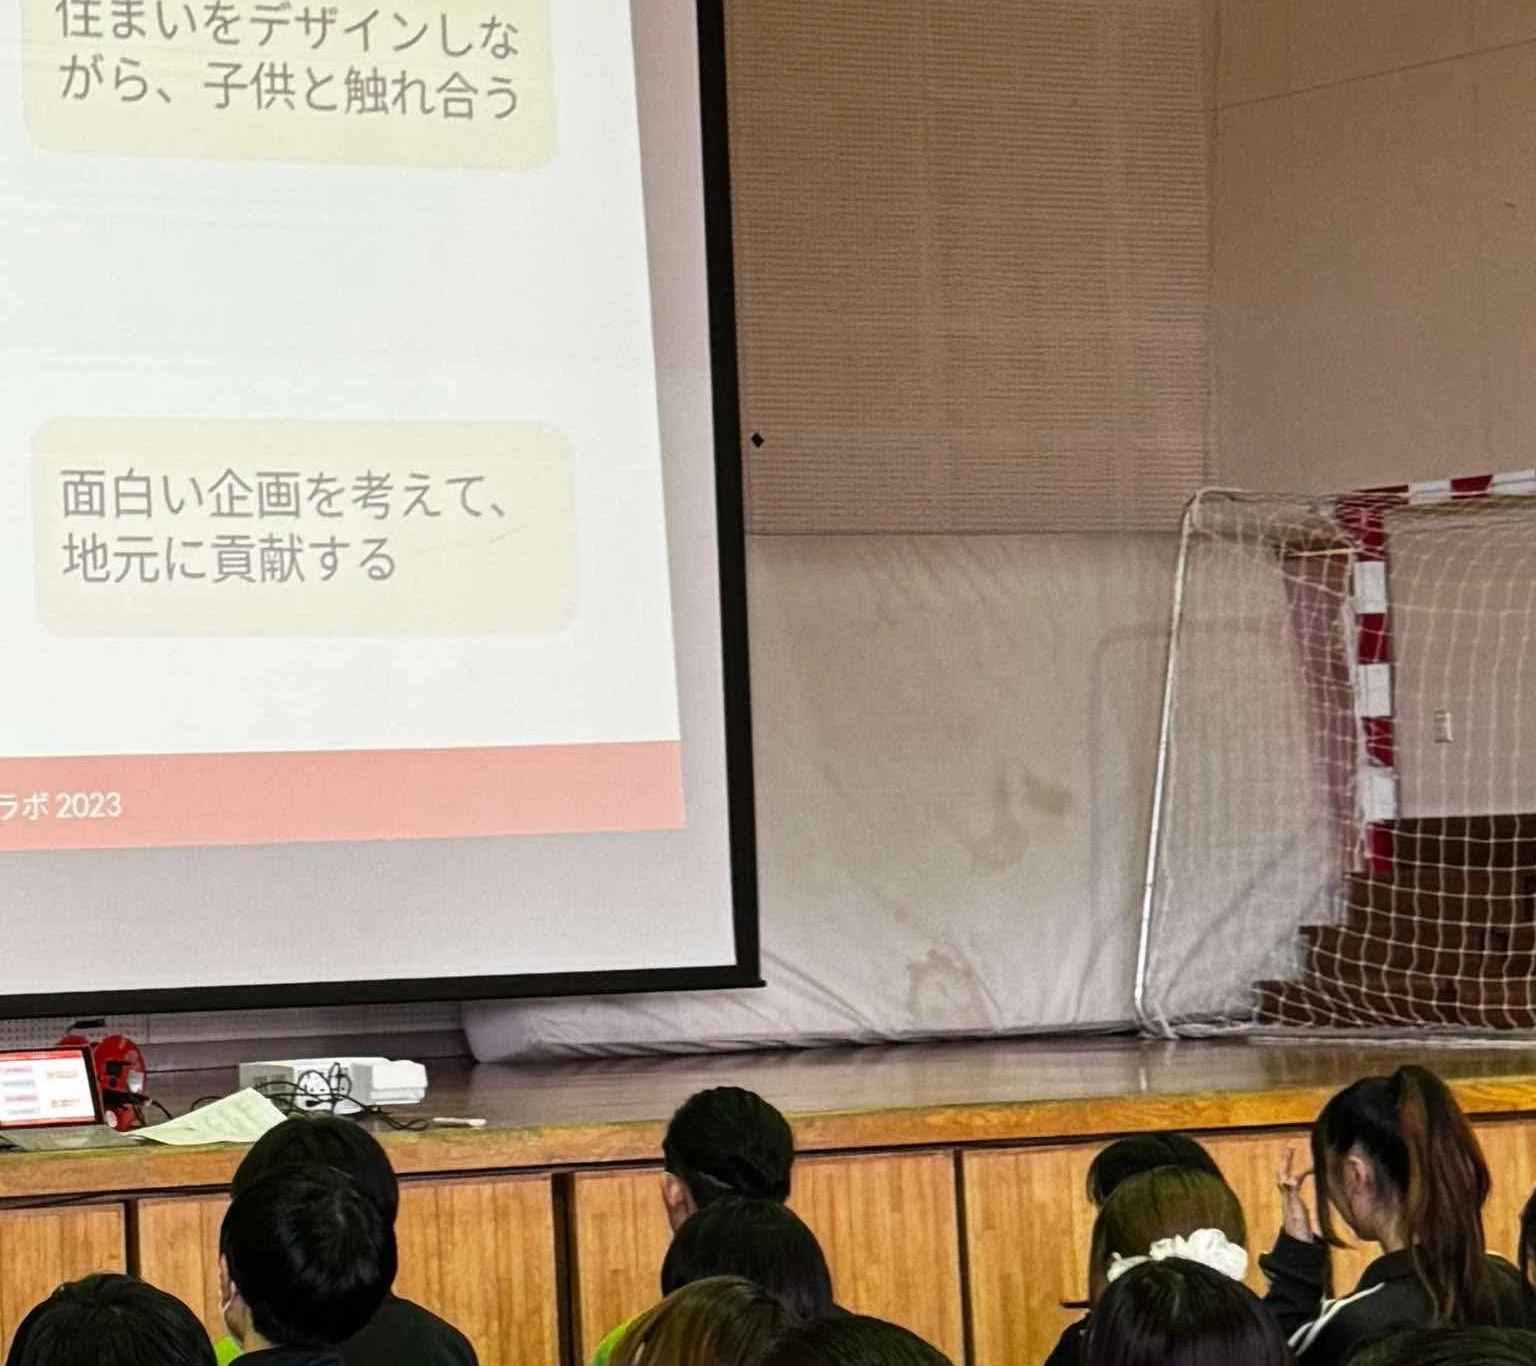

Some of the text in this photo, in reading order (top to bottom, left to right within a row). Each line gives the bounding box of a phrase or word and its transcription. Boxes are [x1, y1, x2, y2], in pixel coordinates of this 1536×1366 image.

[59, 53, 520, 122] がら、子供と触れ合う
[59, 466, 508, 521] 面白い企画を考えて、
[62, 532, 398, 585] 地元に貢献する
[56, 792, 122, 820] 2023
